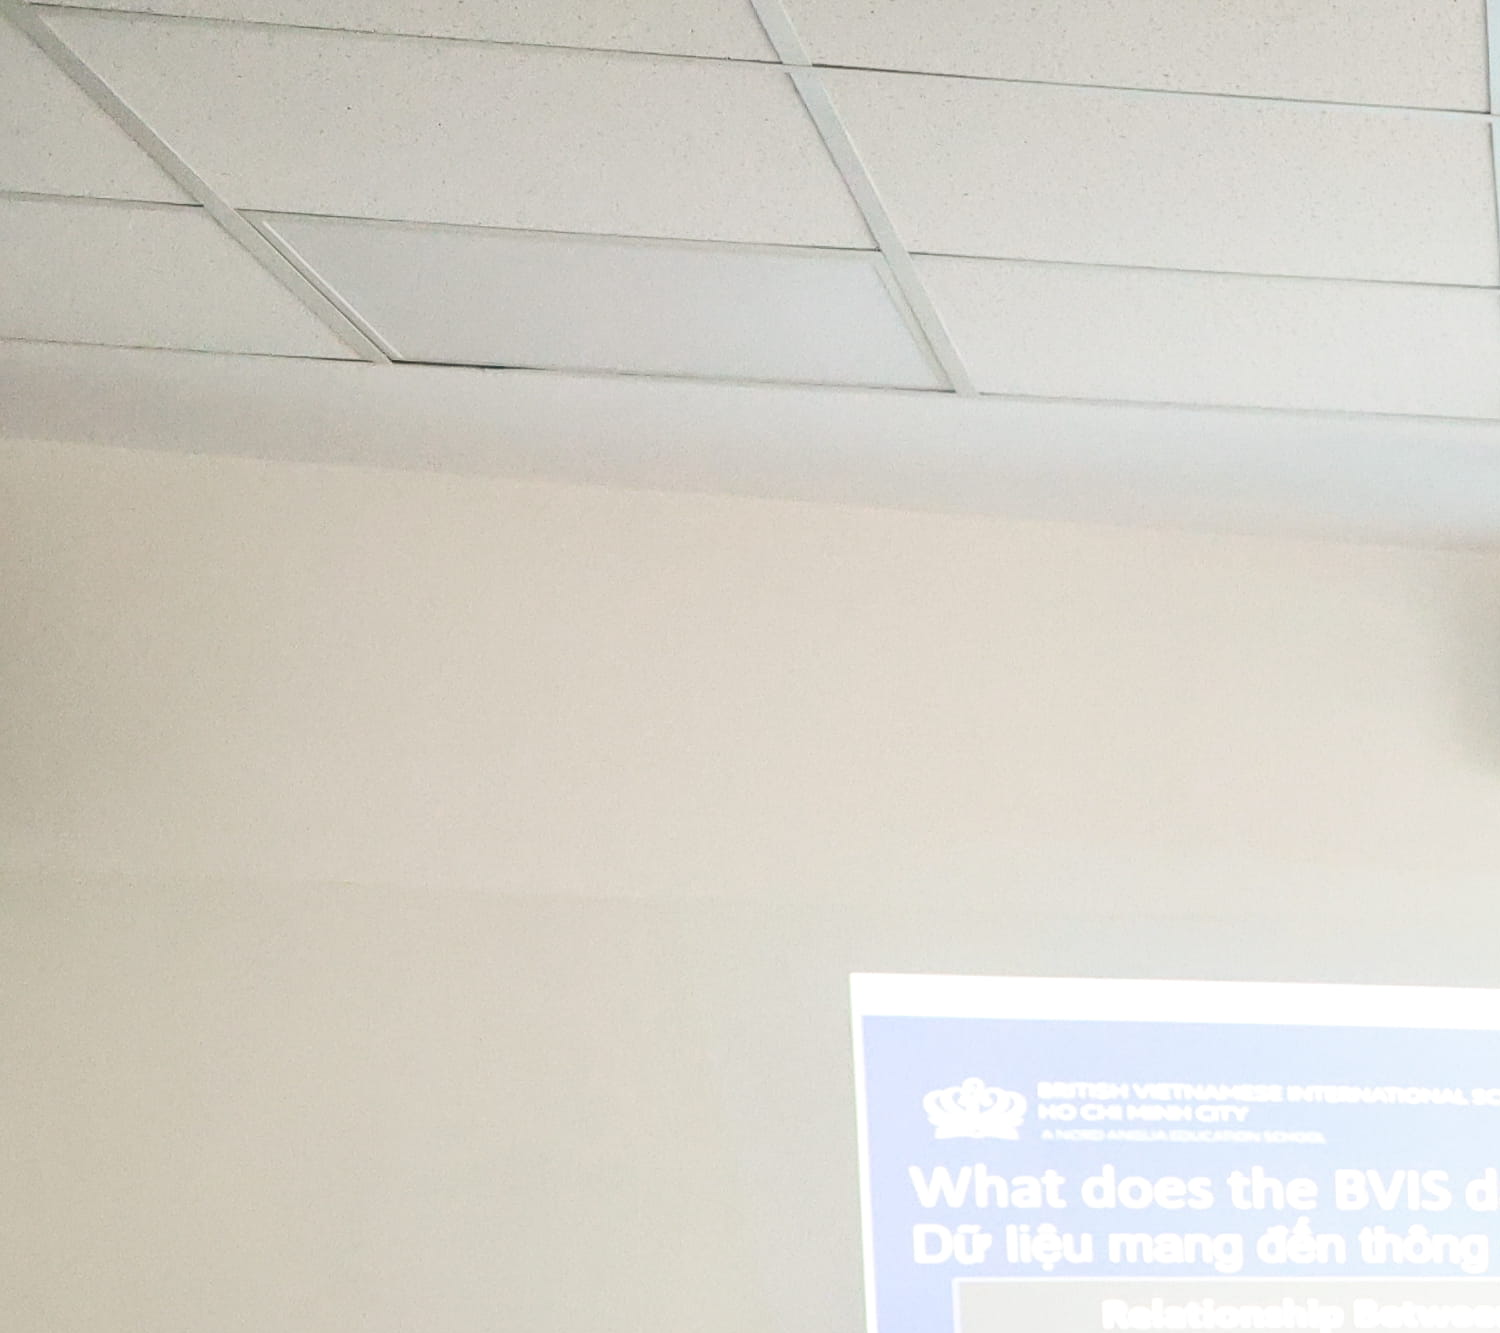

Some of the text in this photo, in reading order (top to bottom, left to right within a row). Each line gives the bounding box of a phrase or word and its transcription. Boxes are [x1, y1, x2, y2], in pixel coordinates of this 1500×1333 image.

[1037, 1081, 1129, 1100] BRITISH
[1132, 1082, 1283, 1102] VIETNAMESE
[1286, 1085, 1470, 1105] INTERNATIONAL
[1037, 1103, 1077, 1121] HO
[1195, 1105, 1249, 1122] CITY
[908, 1163, 1066, 1209] What
[1082, 1164, 1214, 1210] does
[1228, 1165, 1320, 1210] the
[1336, 1169, 1453, 1212] BVIS
[913, 1223, 993, 1265] Dữ
[1005, 1222, 1095, 1271] liệu
[1109, 1233, 1245, 1274] mang
[1258, 1216, 1347, 1264] đến
[1360, 1224, 1489, 1274] thông
